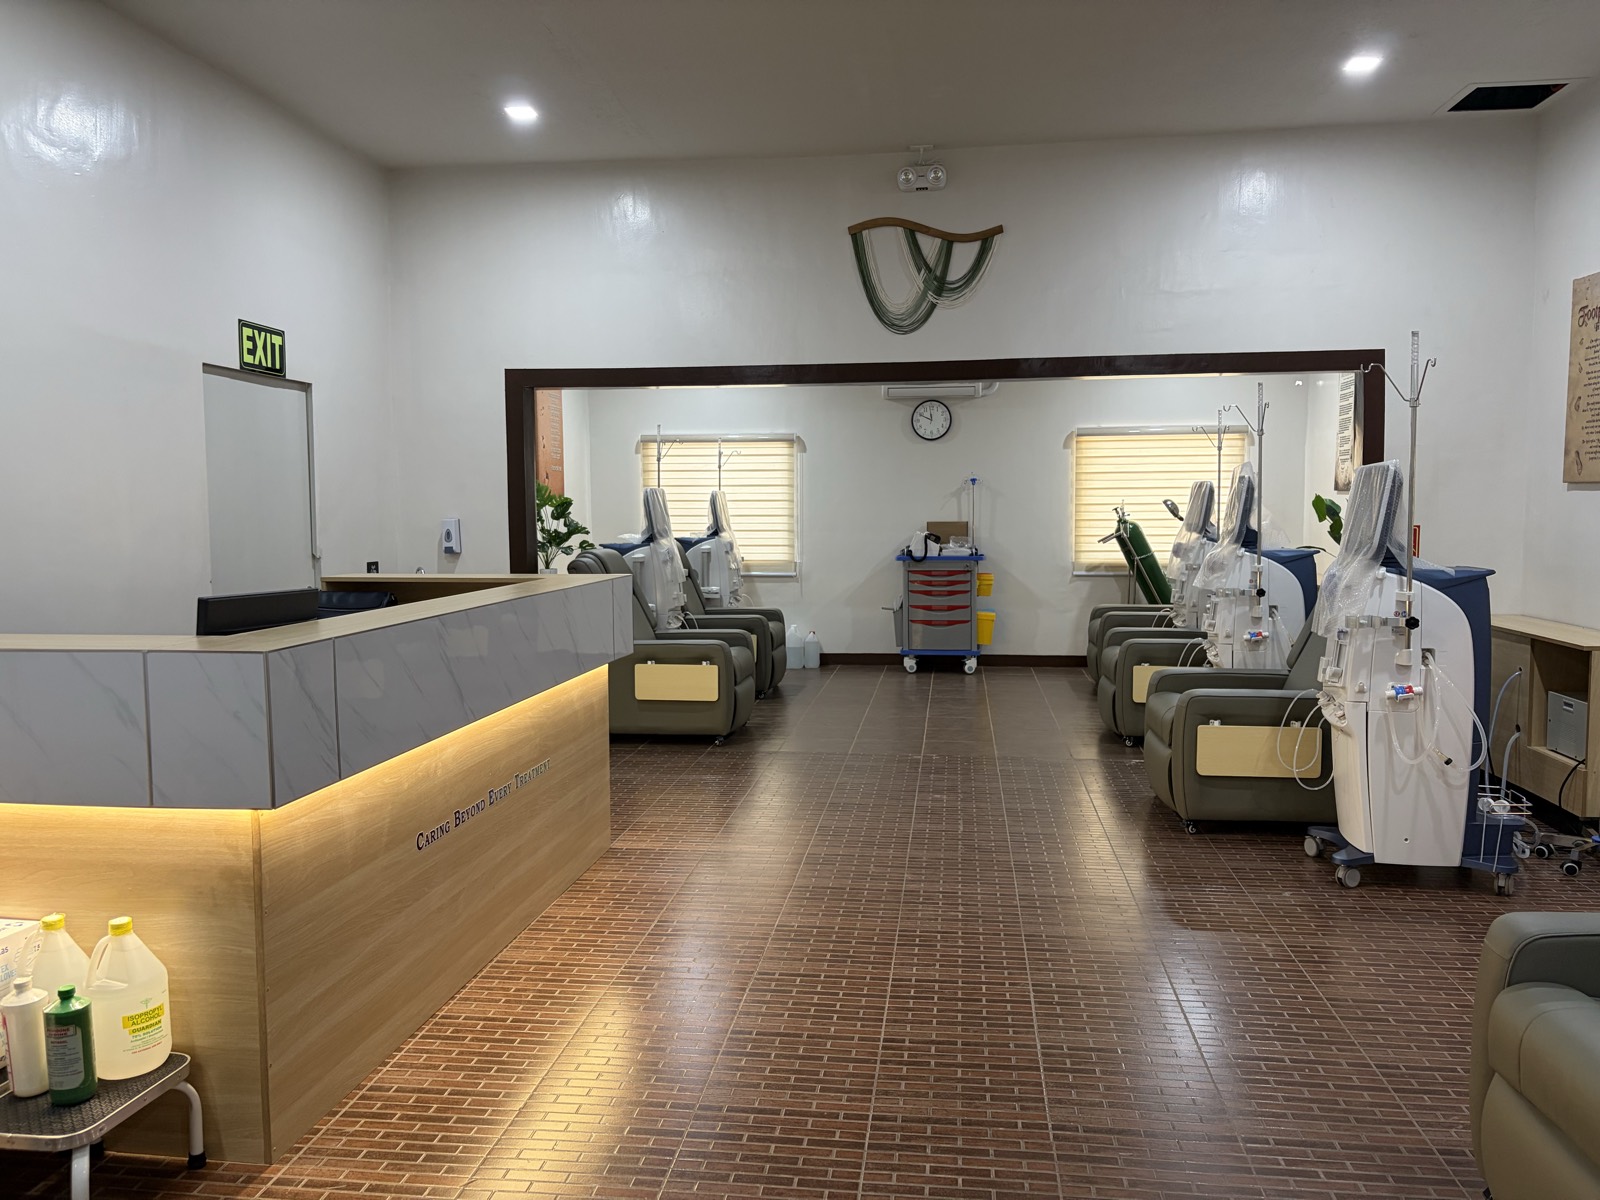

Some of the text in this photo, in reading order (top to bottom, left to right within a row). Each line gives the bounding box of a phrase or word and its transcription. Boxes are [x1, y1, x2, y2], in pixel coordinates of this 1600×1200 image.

[242, 326, 283, 370] EXIT
[416, 758, 551, 851] CARING BEYOND EVERY TREATMENT
[0, 946, 9, 955] as
[127, 1004, 163, 1022] ISOPROPYL
[131, 1012, 162, 1027] ALCOHOL
[131, 1019, 162, 1034] GUARDIAN
